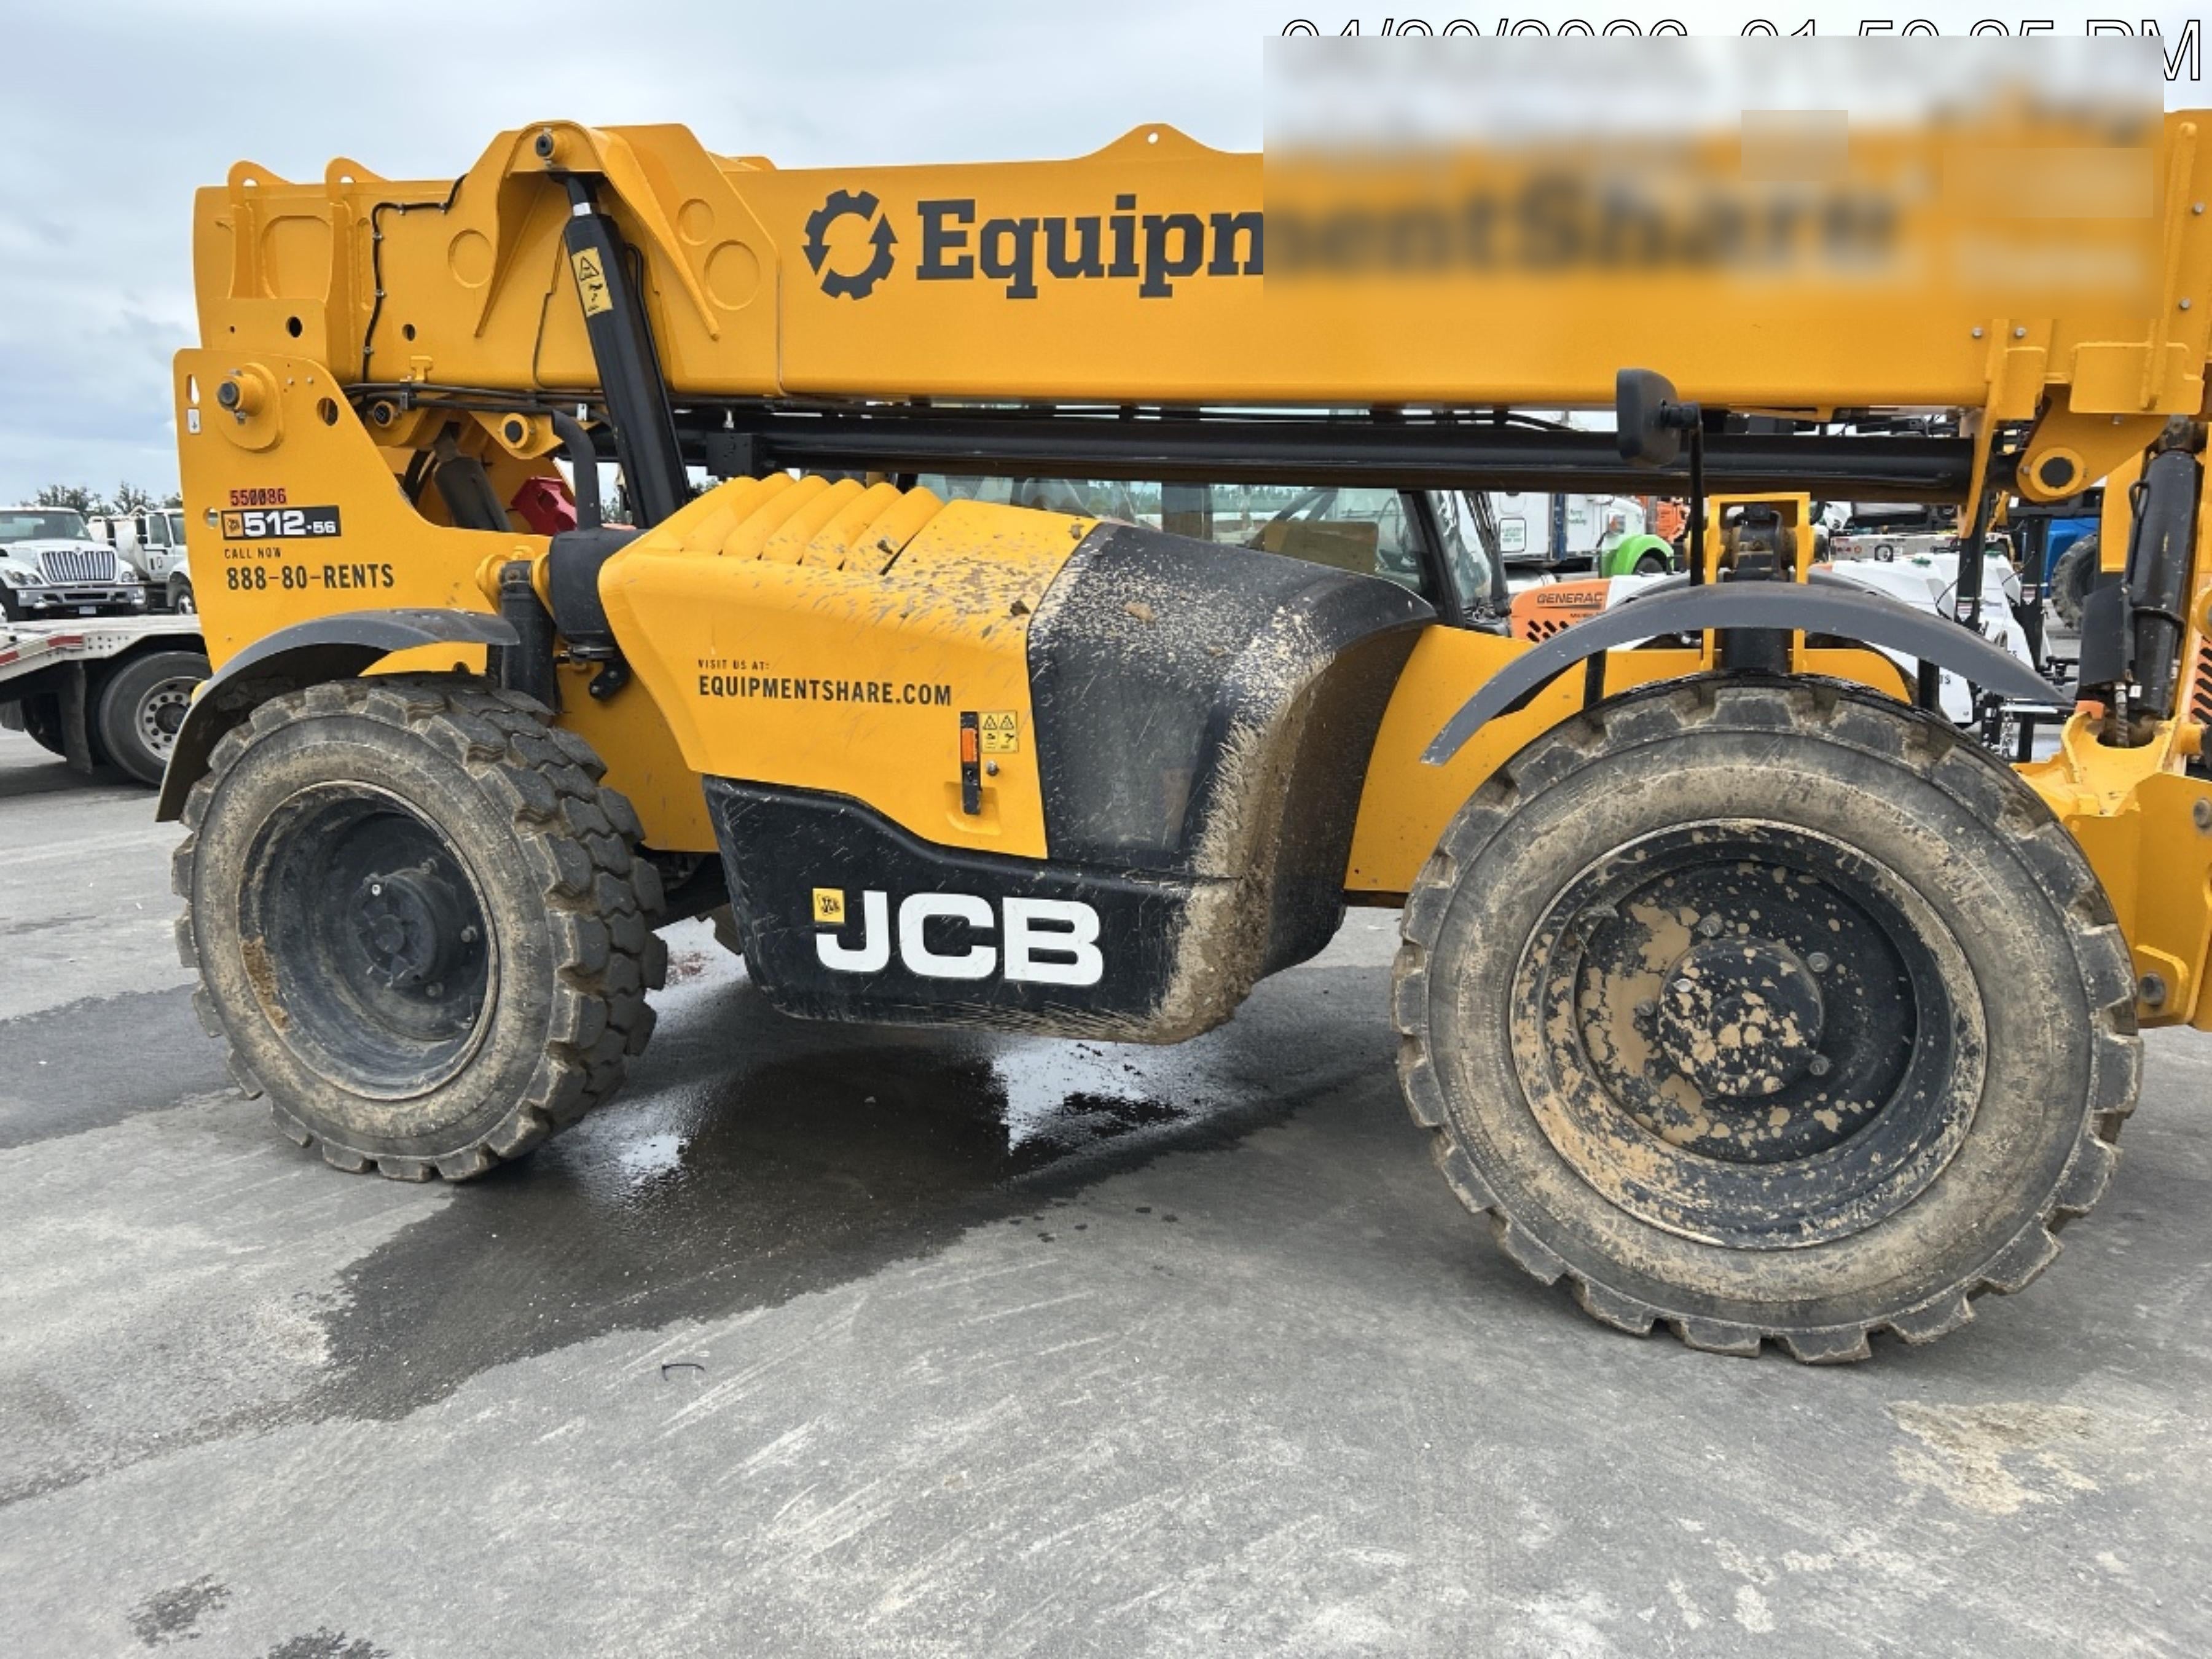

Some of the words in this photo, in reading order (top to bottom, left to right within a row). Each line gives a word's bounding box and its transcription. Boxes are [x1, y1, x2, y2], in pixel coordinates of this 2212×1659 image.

[230, 488, 287, 506] 550086
[224, 548, 253, 559] CALL
[257, 547, 281, 558] NOW
[226, 563, 394, 590] 888-80-RENTS
[1537, 592, 1603, 604] GENERAC
[698, 659, 728, 670] VISIT
[733, 659, 747, 670] US
[751, 661, 770, 672] AT:
[699, 675, 952, 705] EQUIPMENTSHARE.COM
[815, 890, 1104, 986] JCB
